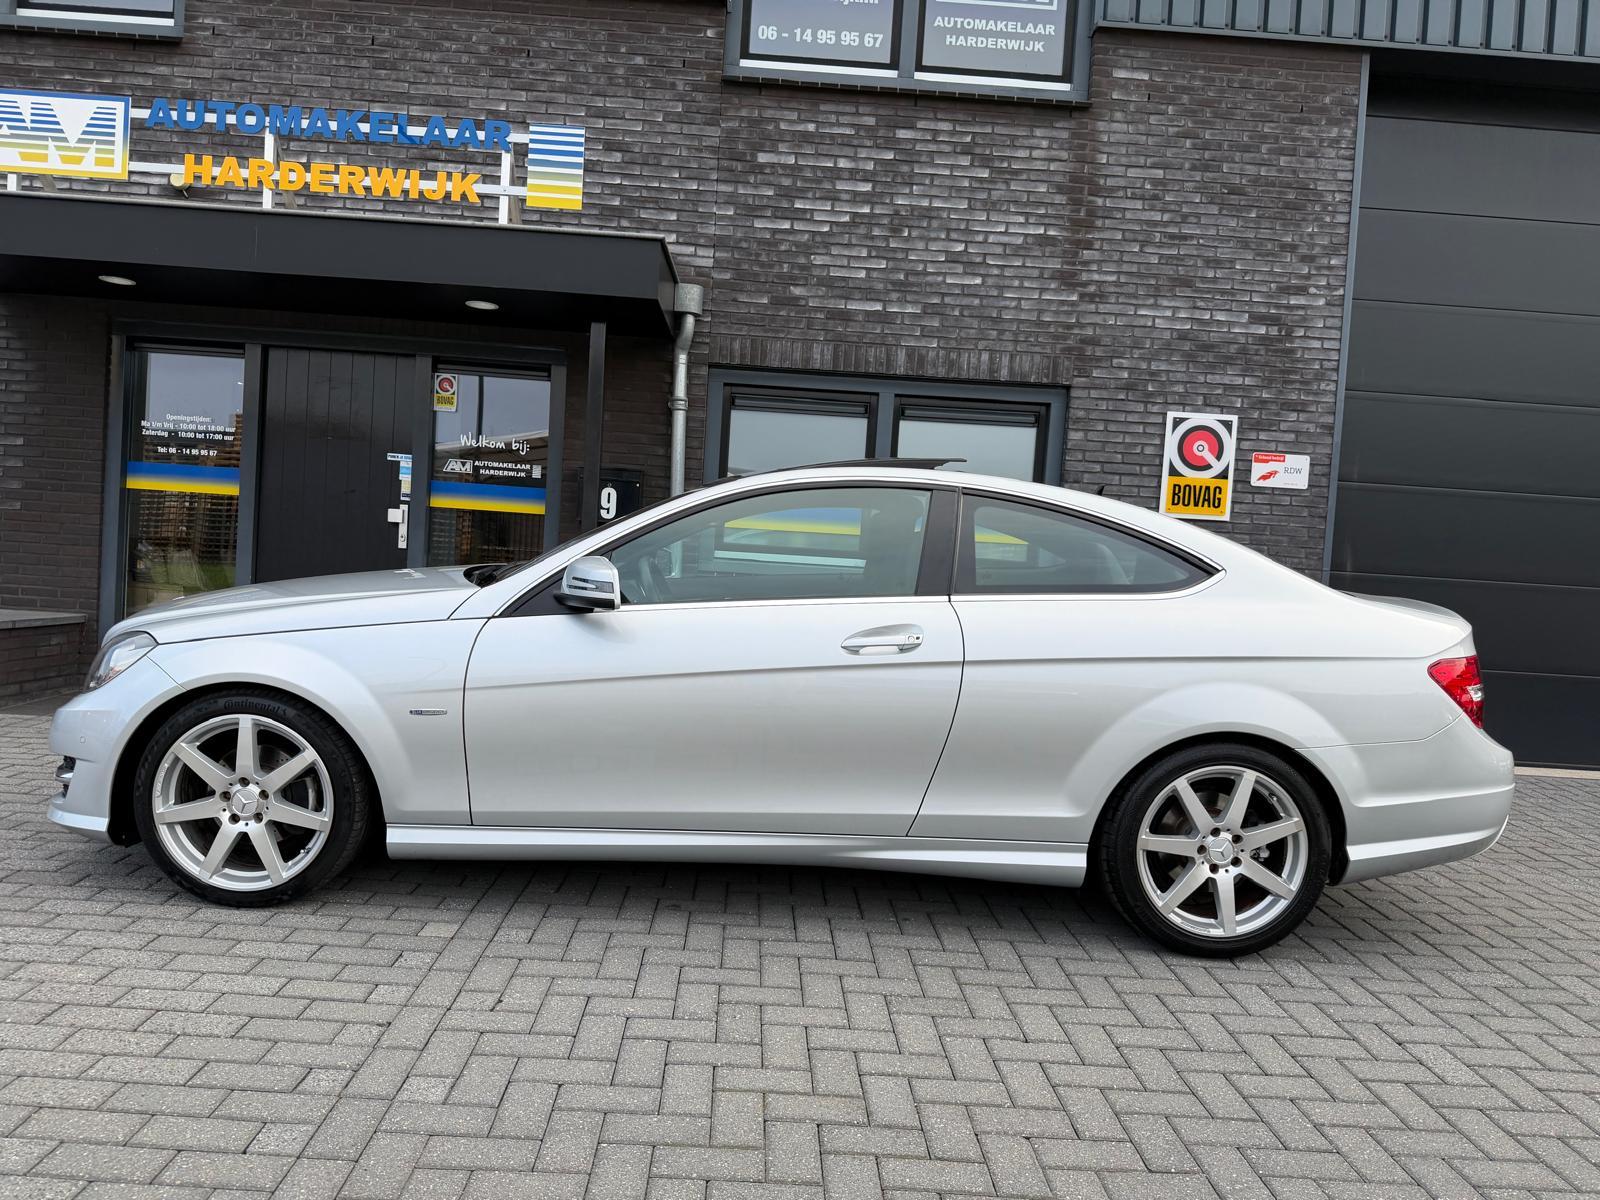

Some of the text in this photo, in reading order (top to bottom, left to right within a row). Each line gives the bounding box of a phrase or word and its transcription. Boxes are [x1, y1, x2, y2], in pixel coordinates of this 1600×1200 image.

[933, 16, 1056, 35] AUTOMAKELAAR
[758, 25, 777, 40] 06
[794, 27, 812, 43] 14
[817, 28, 836, 45] 95
[840, 30, 860, 46] 95
[864, 32, 883, 48] 67
[945, 35, 1045, 52] HARDERWIJK
[145, 98, 512, 151] AUTOMAKELAAR
[183, 154, 482, 203] HARDERWIJK
[163, 421, 174, 429] Vrij
[166, 414, 212, 423] Openingstijden:
[142, 429, 169, 437] Zaterdag
[460, 432, 530, 455] Welkom bij:
[474, 460, 531, 470] AUTOMAKELAAR
[479, 469, 526, 477] HARDERWIJK
[1283, 466, 1303, 475] RDW
[600, 487, 617, 520] 9
[1171, 483, 1223, 509] BOVAG
[224, 699, 280, 714] Continental
